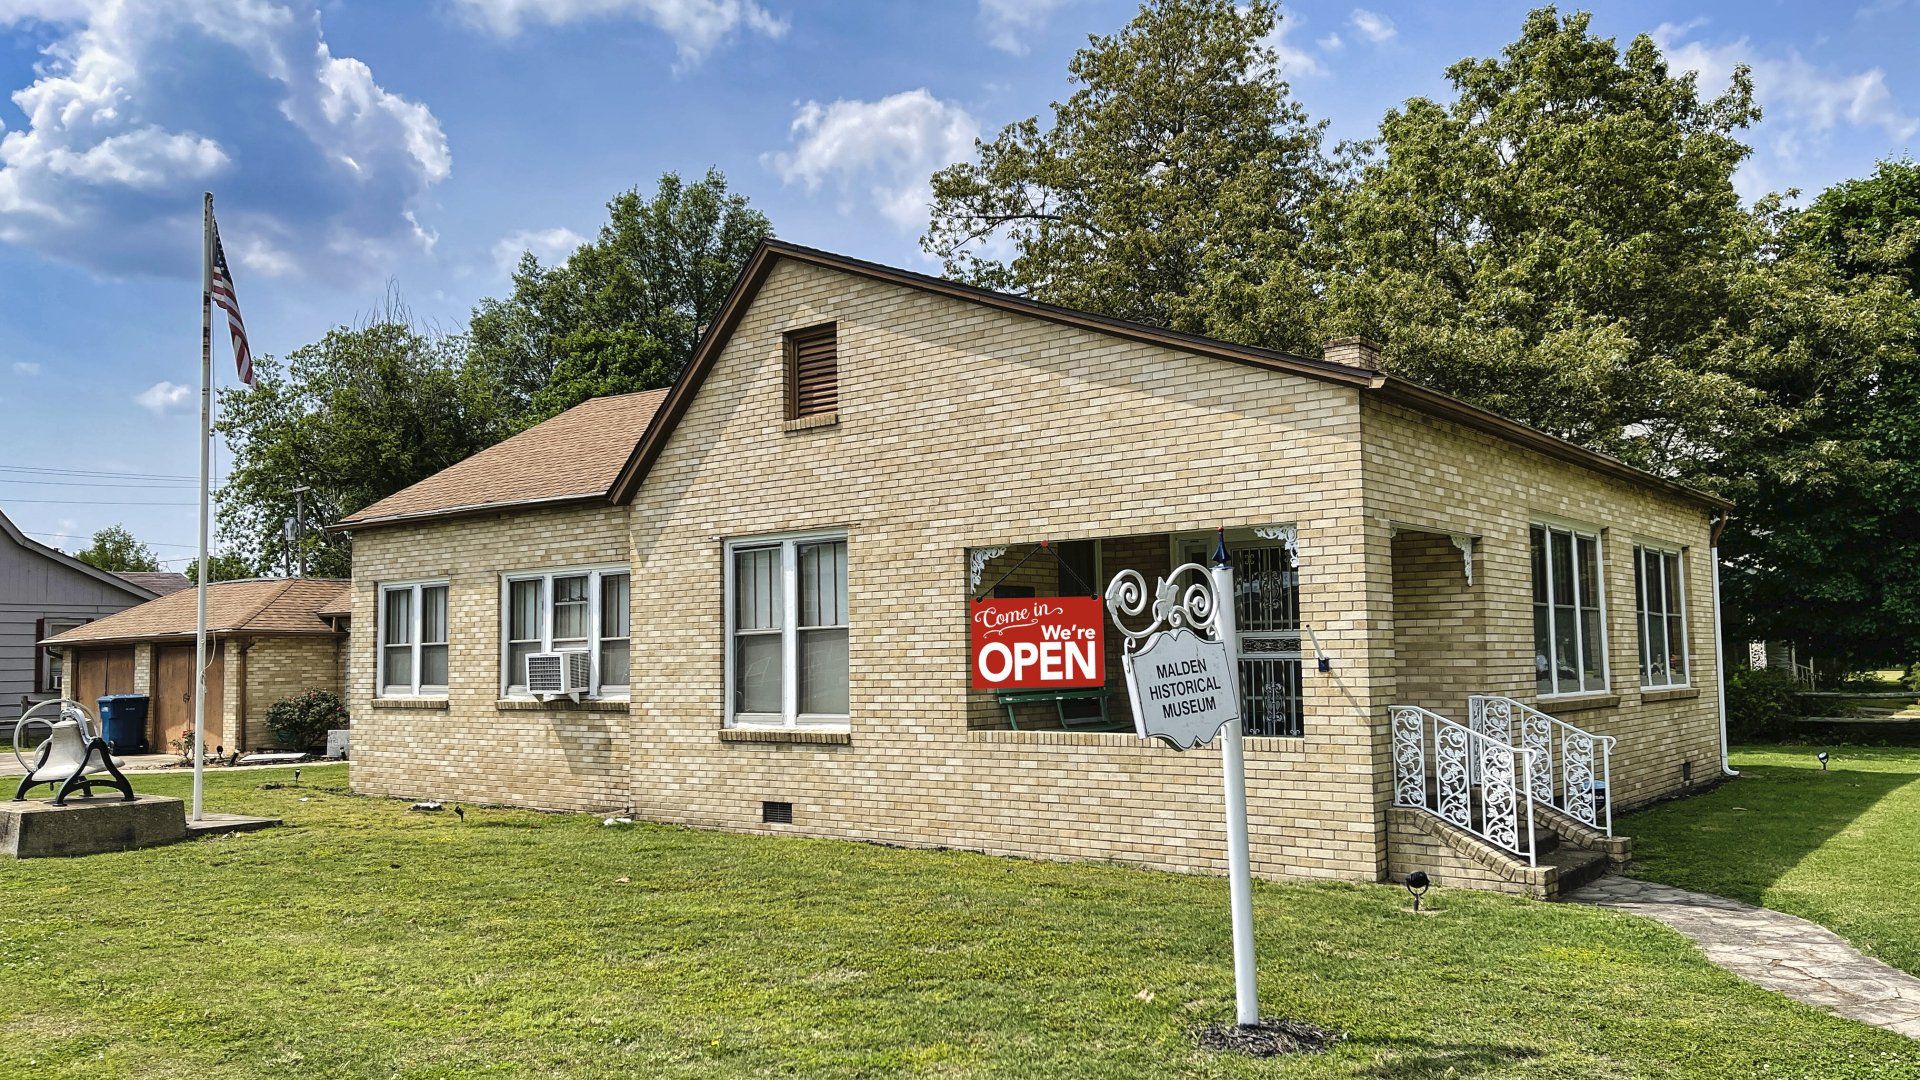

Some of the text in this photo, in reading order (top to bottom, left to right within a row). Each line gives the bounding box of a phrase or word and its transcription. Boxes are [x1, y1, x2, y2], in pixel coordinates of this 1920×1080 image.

[975, 602, 1063, 628] Come in
[1041, 624, 1096, 640] We're
[978, 640, 1097, 682] OPEN
[1156, 658, 1207, 679] MALDEN
[1149, 676, 1221, 701] HISTORICAL
[1162, 696, 1216, 719] MUSEUM
